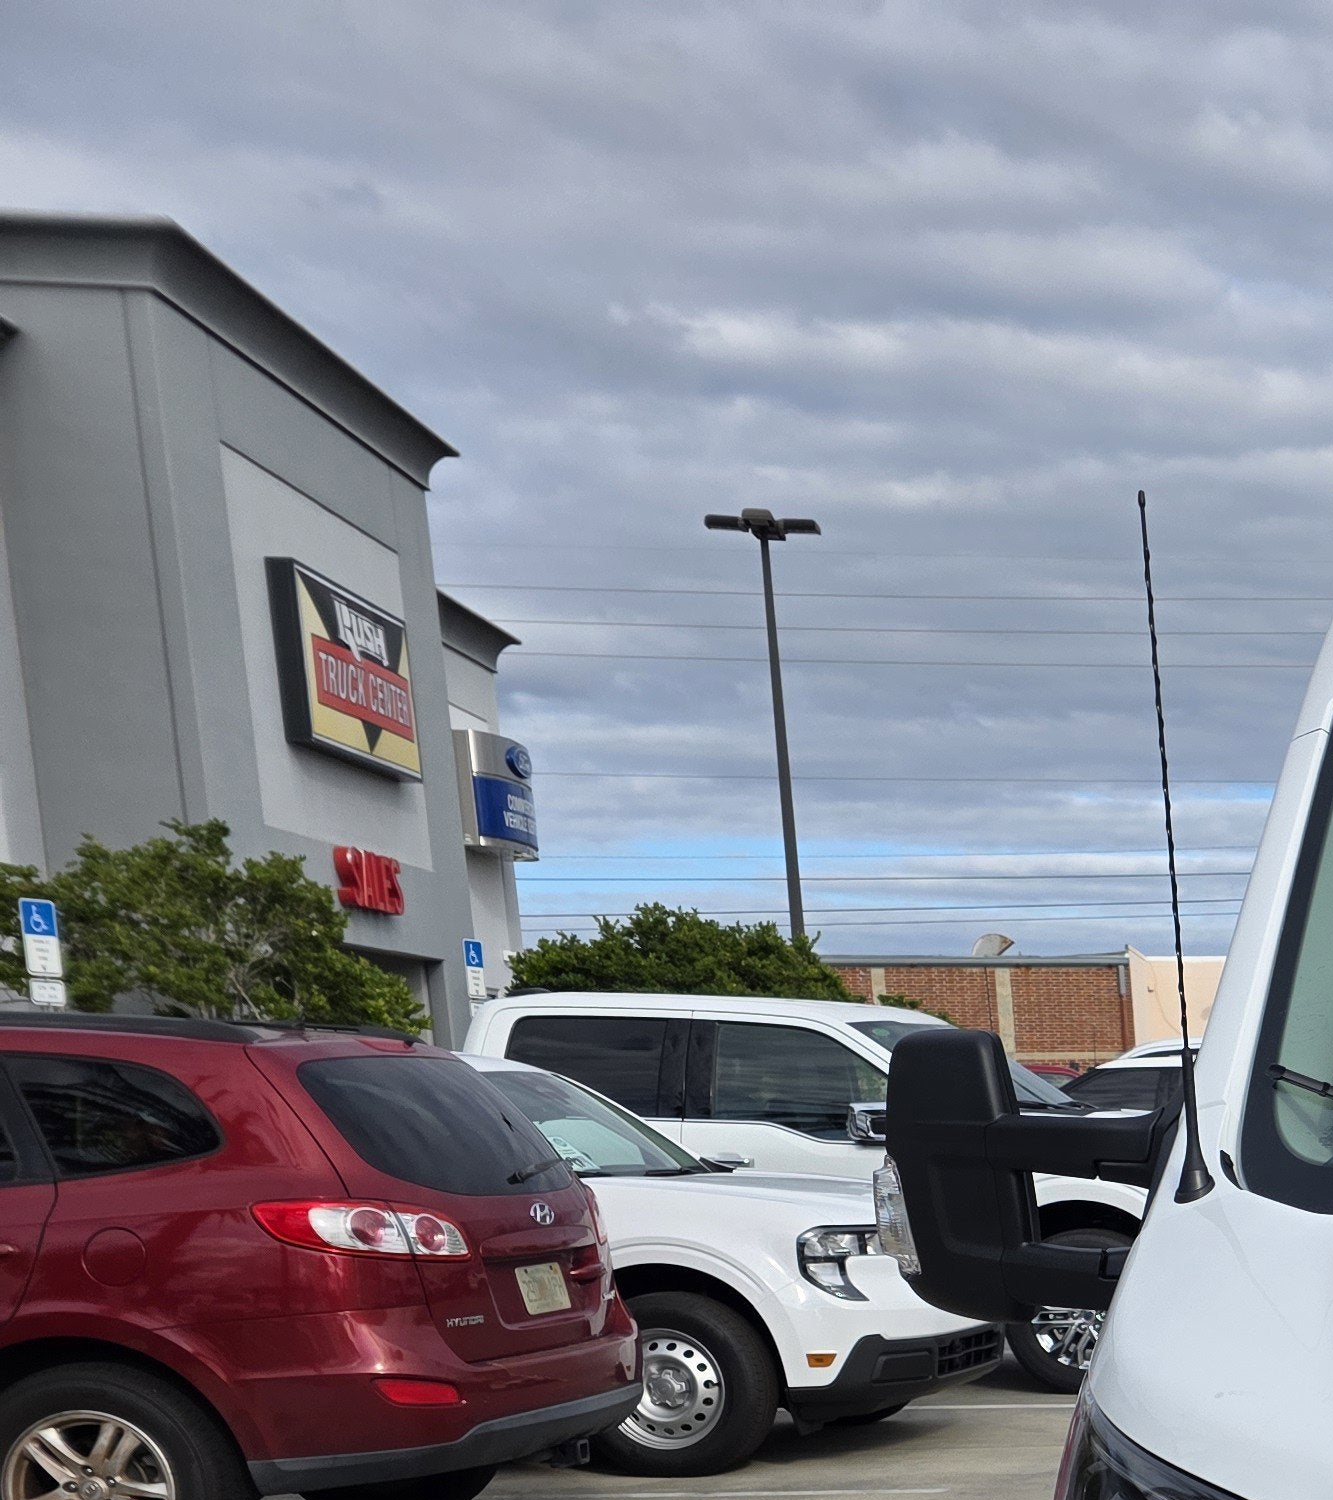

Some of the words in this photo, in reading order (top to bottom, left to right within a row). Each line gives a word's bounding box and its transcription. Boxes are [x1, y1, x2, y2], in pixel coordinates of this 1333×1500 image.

[332, 594, 389, 667] RUSH
[319, 652, 367, 708] TRUCK
[369, 674, 410, 726] CENTER
[334, 846, 405, 916] SALES
[446, 1315, 484, 1328] HYUNDAI
